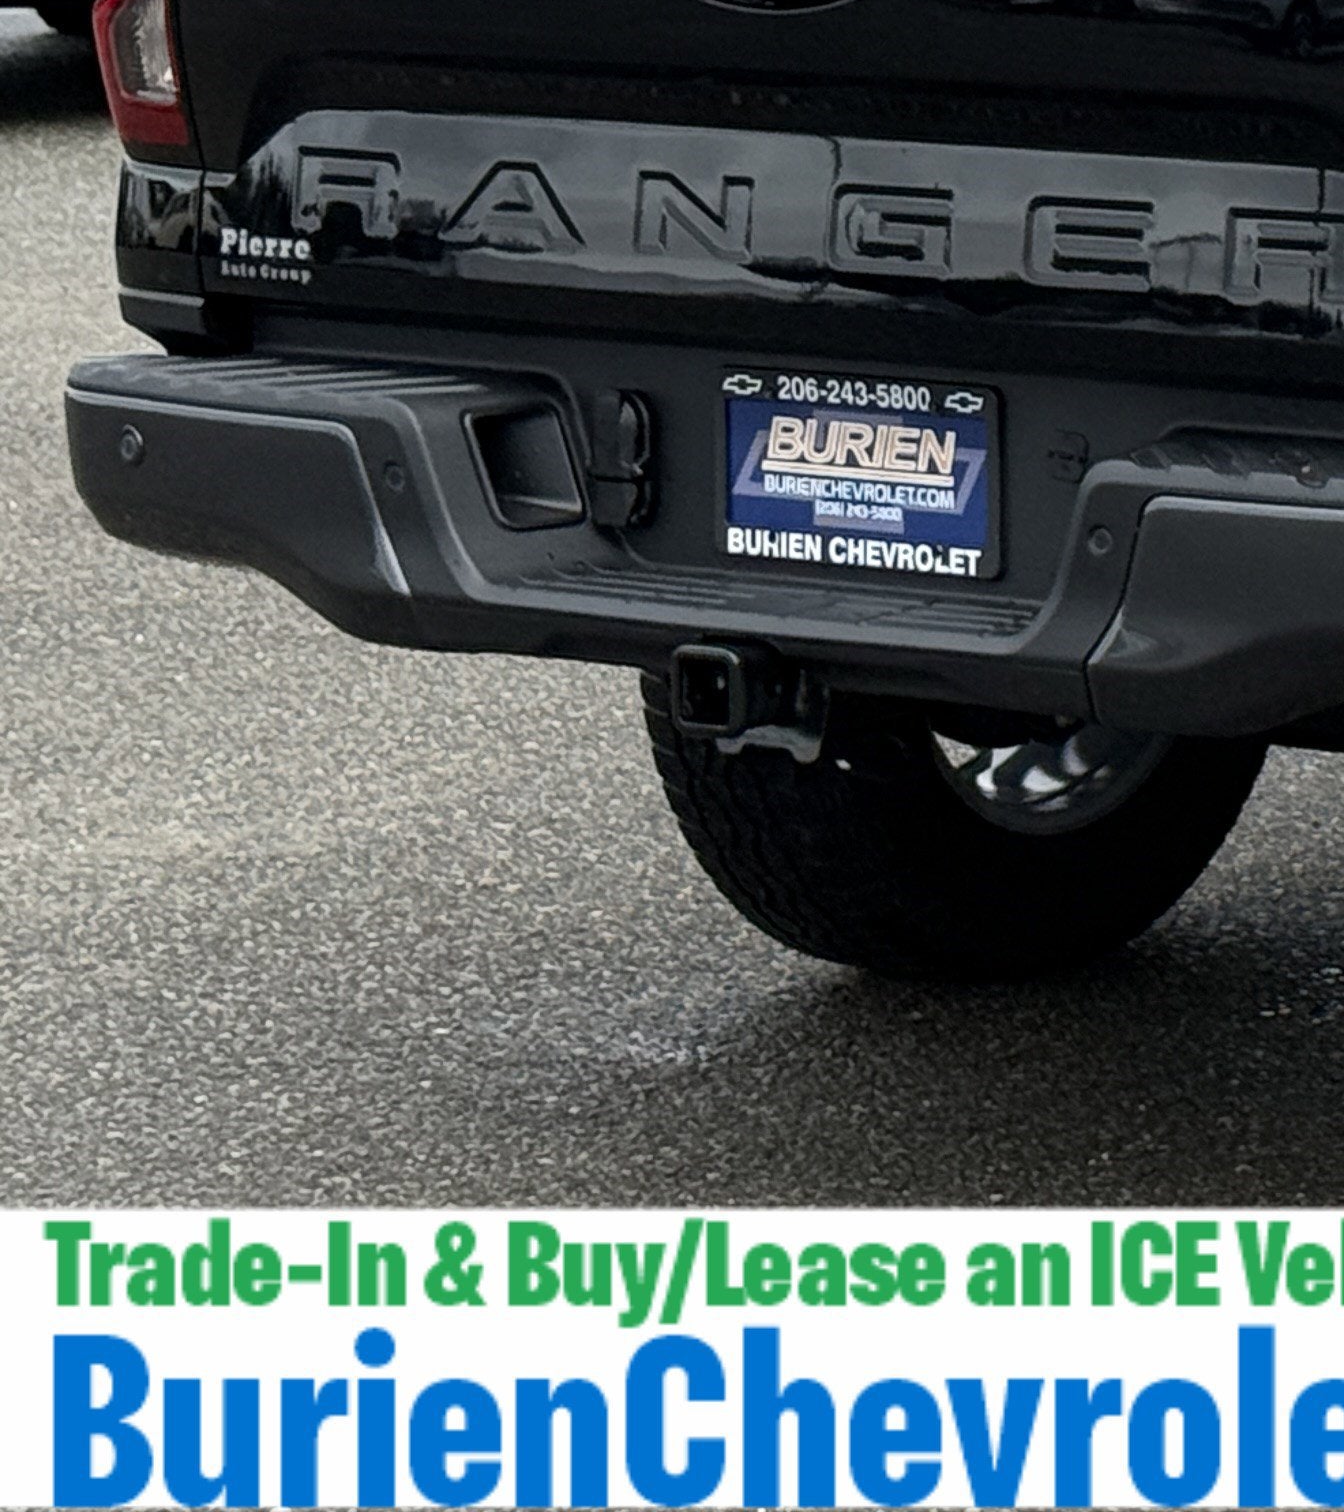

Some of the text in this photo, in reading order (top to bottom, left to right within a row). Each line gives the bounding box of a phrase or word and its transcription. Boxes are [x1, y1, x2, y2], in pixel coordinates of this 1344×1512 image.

[220, 228, 312, 261] Pierre
[221, 260, 312, 285] Auto Group
[776, 375, 931, 411] 206-243-5800
[766, 415, 957, 475] BURIEN
[763, 473, 956, 510] BURIENCHEVROLET.COM
[828, 536, 983, 577] CHEVROLET
